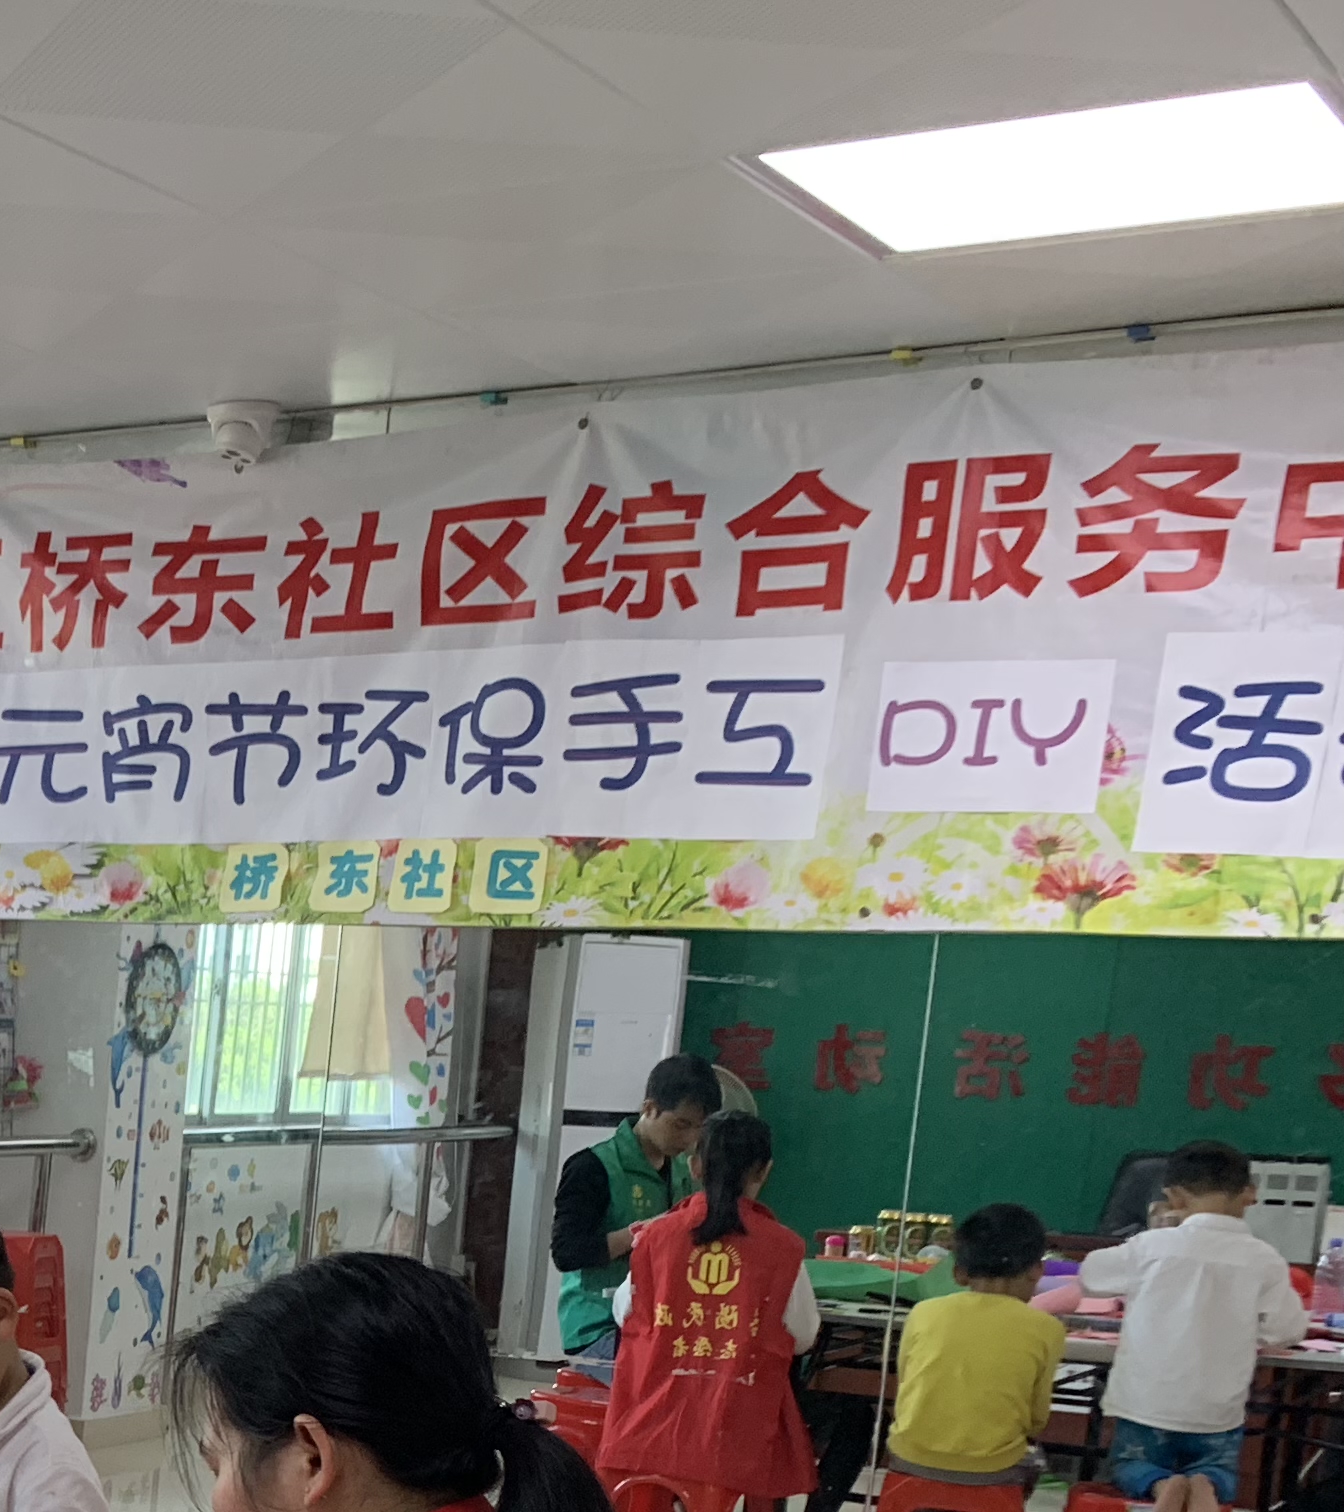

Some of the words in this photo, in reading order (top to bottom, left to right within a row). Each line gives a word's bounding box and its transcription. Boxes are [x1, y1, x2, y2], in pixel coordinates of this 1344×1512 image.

[879, 697, 1087, 767] DIY
[1163, 680, 1344, 801] 活
[229, 848, 540, 902] 桥东社区
